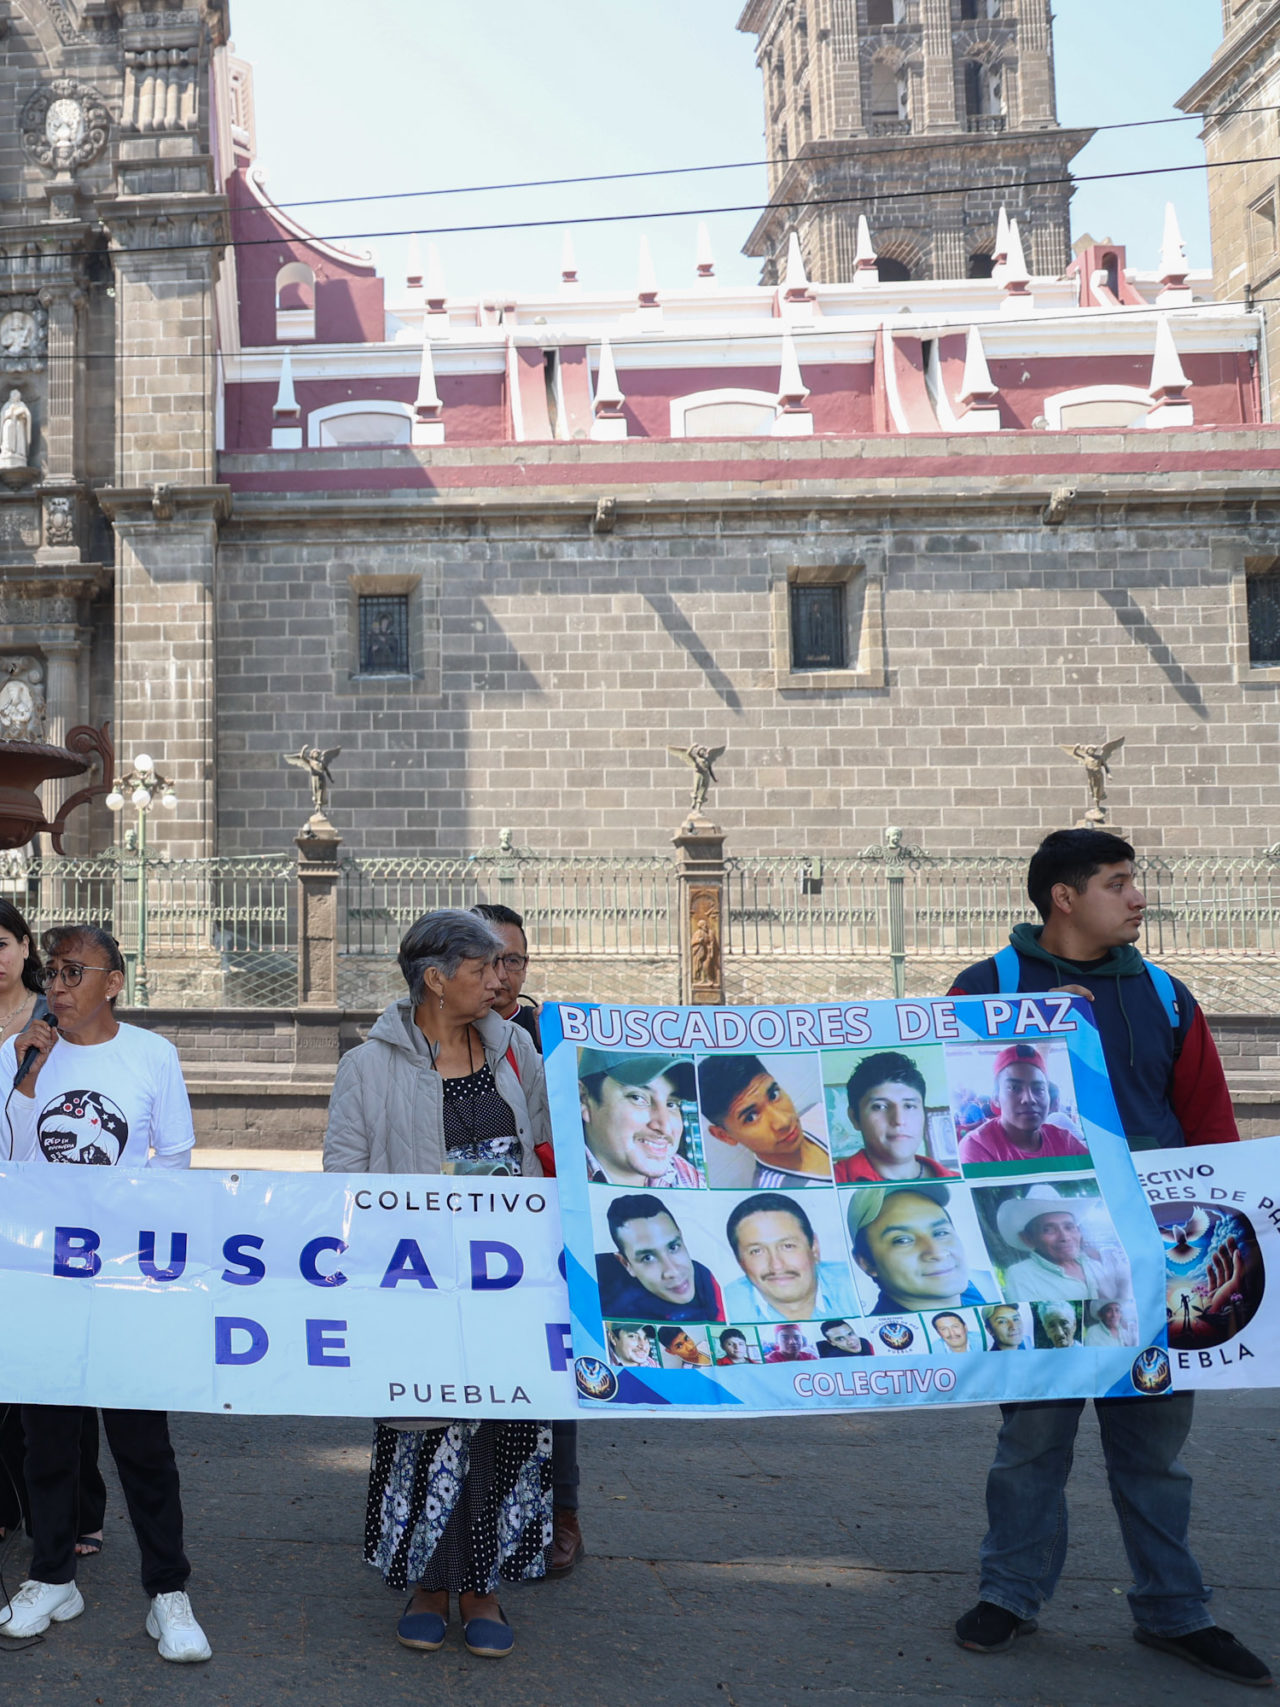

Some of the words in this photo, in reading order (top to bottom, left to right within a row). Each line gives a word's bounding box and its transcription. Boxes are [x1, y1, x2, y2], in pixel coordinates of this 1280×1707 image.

[558, 1003, 872, 1048] BUSCADORES
[895, 1002, 959, 1041] DE
[983, 996, 1077, 1036] PAZ
[354, 1189, 547, 1214] COLECTIVO
[1210, 1187, 1247, 1202] DE
[53, 1226, 568, 1291] BUSCAD
[214, 1315, 351, 1368] DE
[389, 1382, 532, 1405] PUEBLA
[793, 1367, 957, 1397] COLECTIVO
